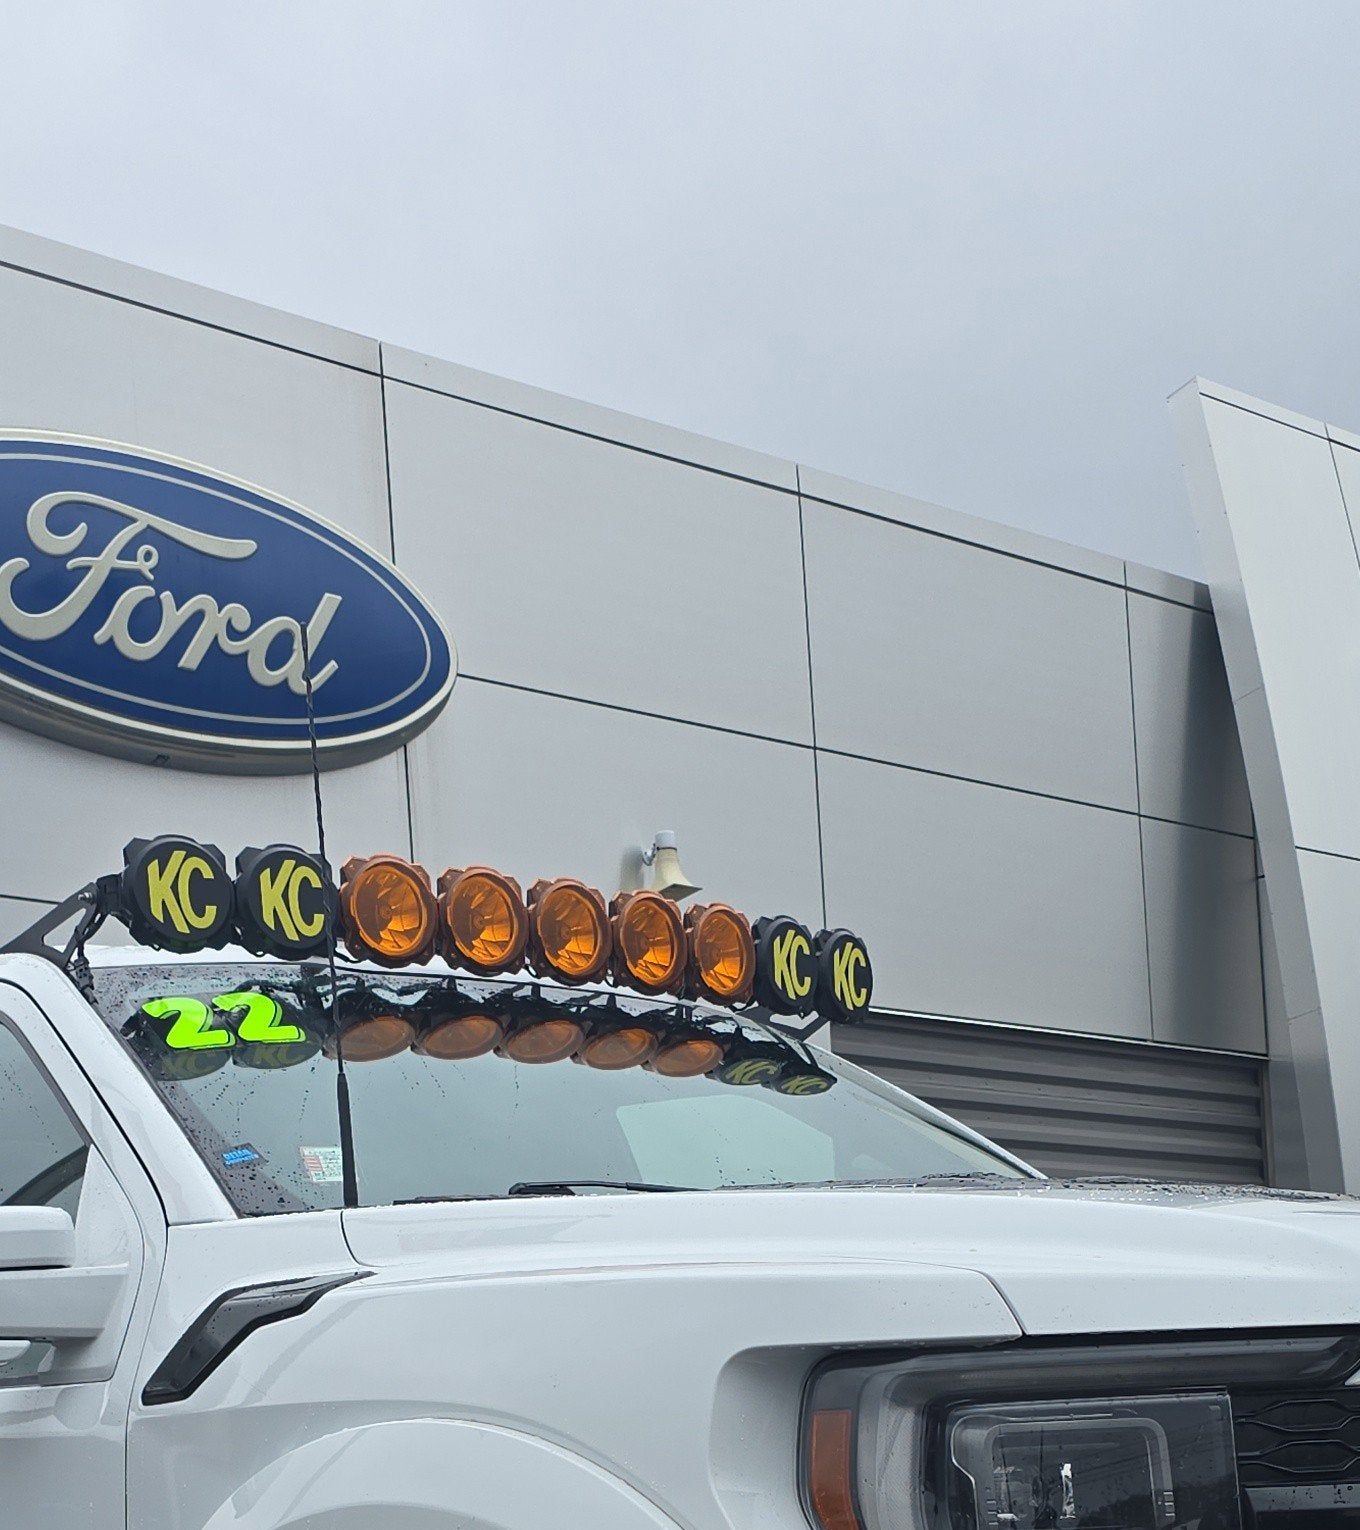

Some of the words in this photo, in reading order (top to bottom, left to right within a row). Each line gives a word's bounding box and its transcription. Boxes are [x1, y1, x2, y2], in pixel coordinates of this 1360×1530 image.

[147, 850, 217, 934] KC
[259, 859, 325, 941] KC
[773, 929, 812, 1000] KC
[833, 942, 868, 1011] KC
[142, 992, 306, 1050] 22
